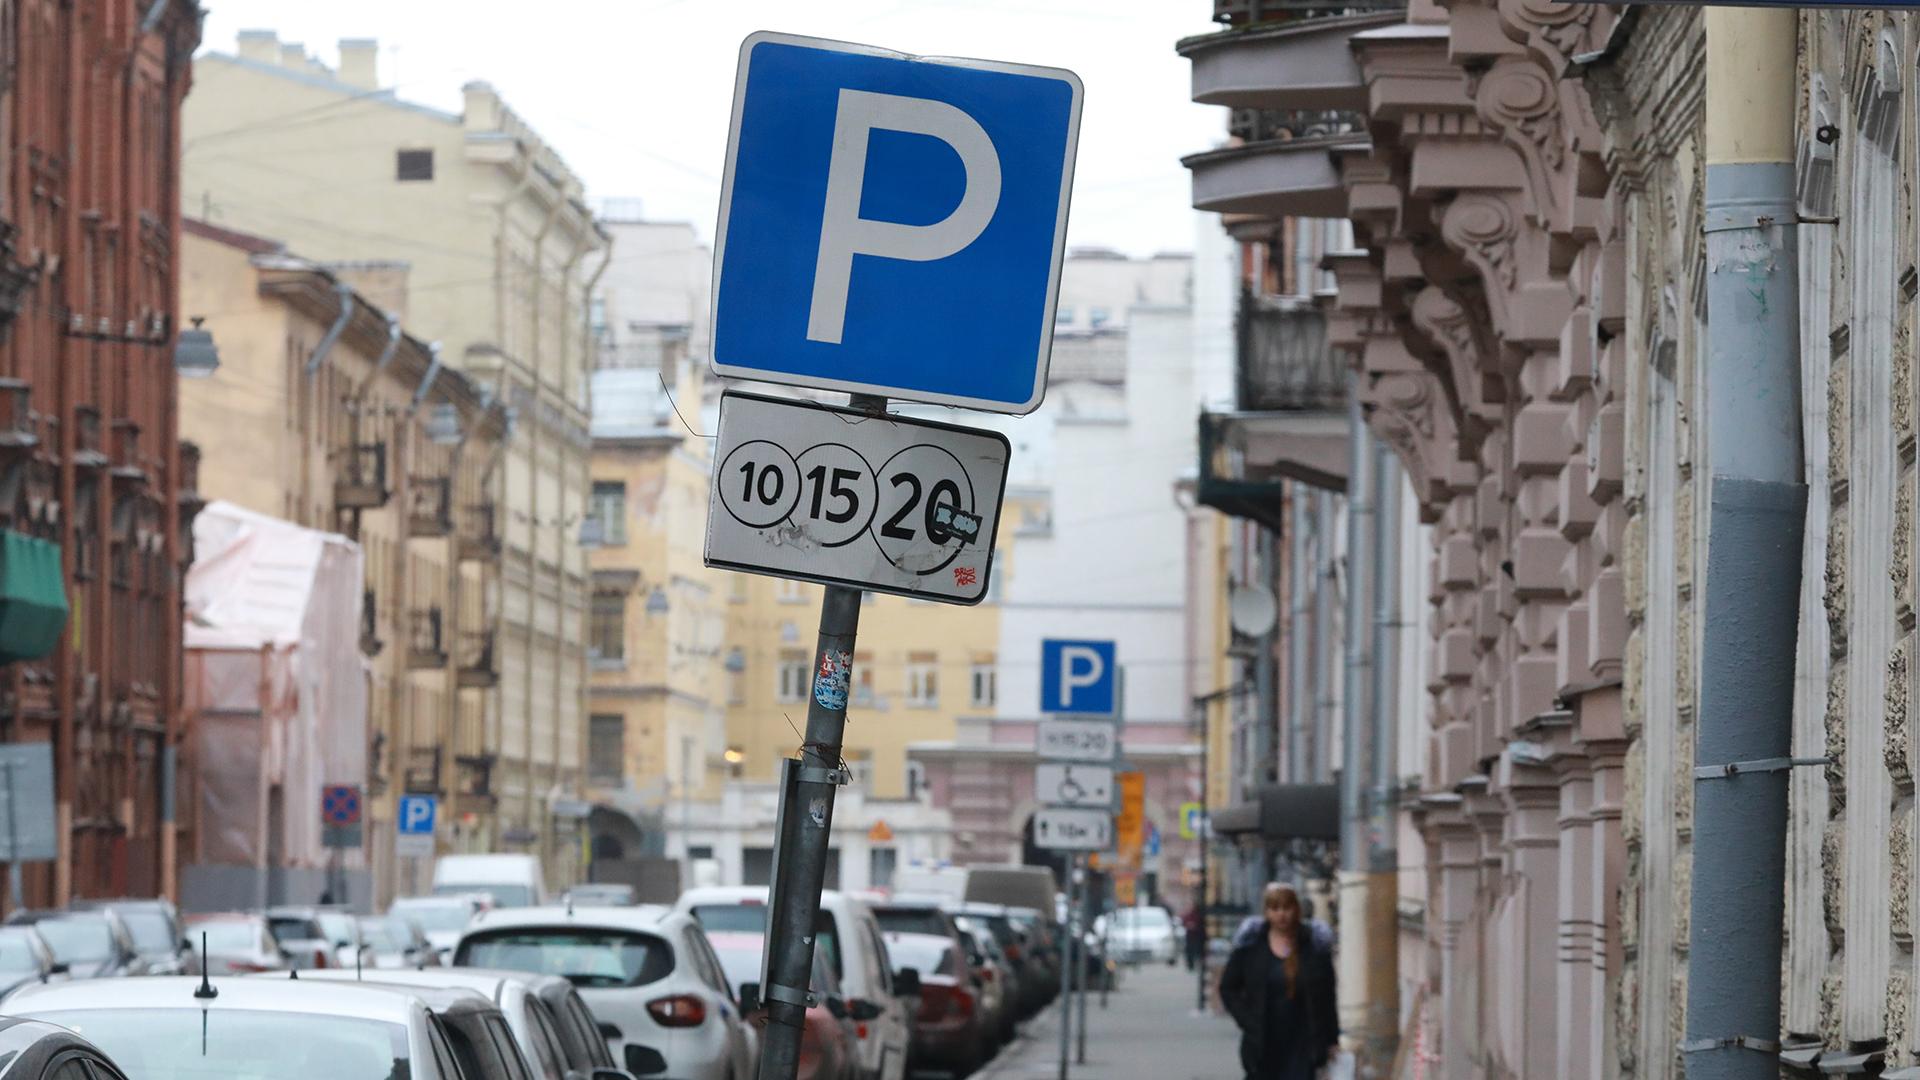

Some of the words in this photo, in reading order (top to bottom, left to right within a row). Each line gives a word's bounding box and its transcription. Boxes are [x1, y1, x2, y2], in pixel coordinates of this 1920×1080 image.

[806, 88, 1002, 345] P
[739, 461, 784, 506] 10
[806, 465, 861, 524] 15
[881, 472, 962, 545] 20
[1059, 646, 1104, 707] P
[1081, 731, 1106, 750] 20
[406, 797, 430, 831] P
